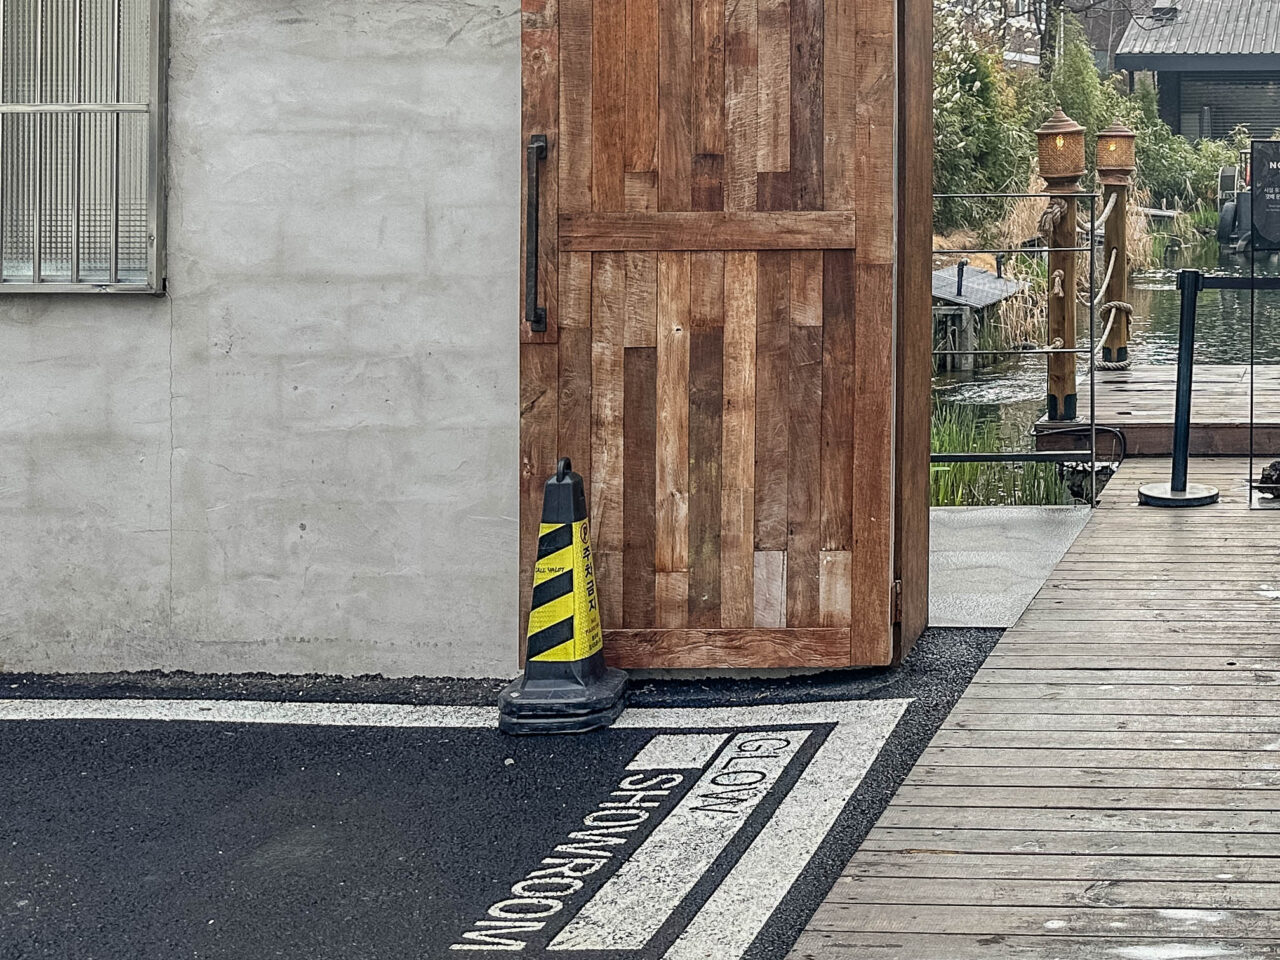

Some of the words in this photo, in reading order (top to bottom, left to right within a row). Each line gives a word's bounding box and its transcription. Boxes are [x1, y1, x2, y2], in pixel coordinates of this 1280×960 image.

[583, 545, 597, 612] 주차금지
[688, 737, 790, 814] GLOW
[449, 771, 684, 951] SHOWROOM
